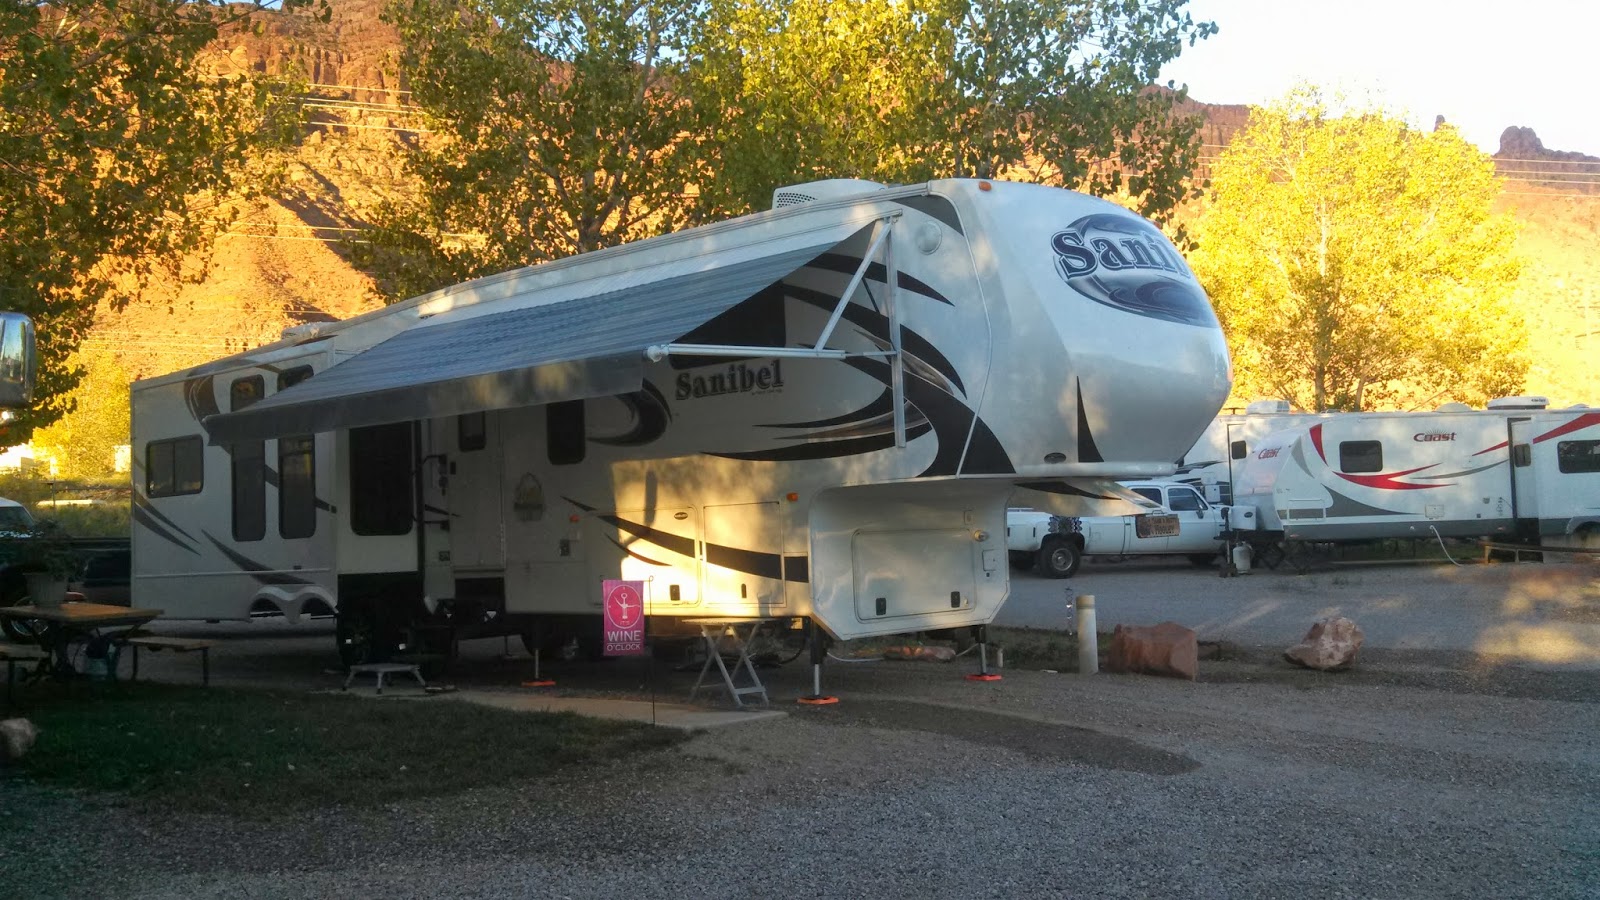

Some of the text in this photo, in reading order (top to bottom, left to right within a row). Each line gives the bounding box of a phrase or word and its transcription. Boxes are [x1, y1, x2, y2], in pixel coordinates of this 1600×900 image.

[675, 359, 784, 400] Sanibel
[1413, 431, 1457, 443] Coast
[607, 630, 641, 642] WINE
